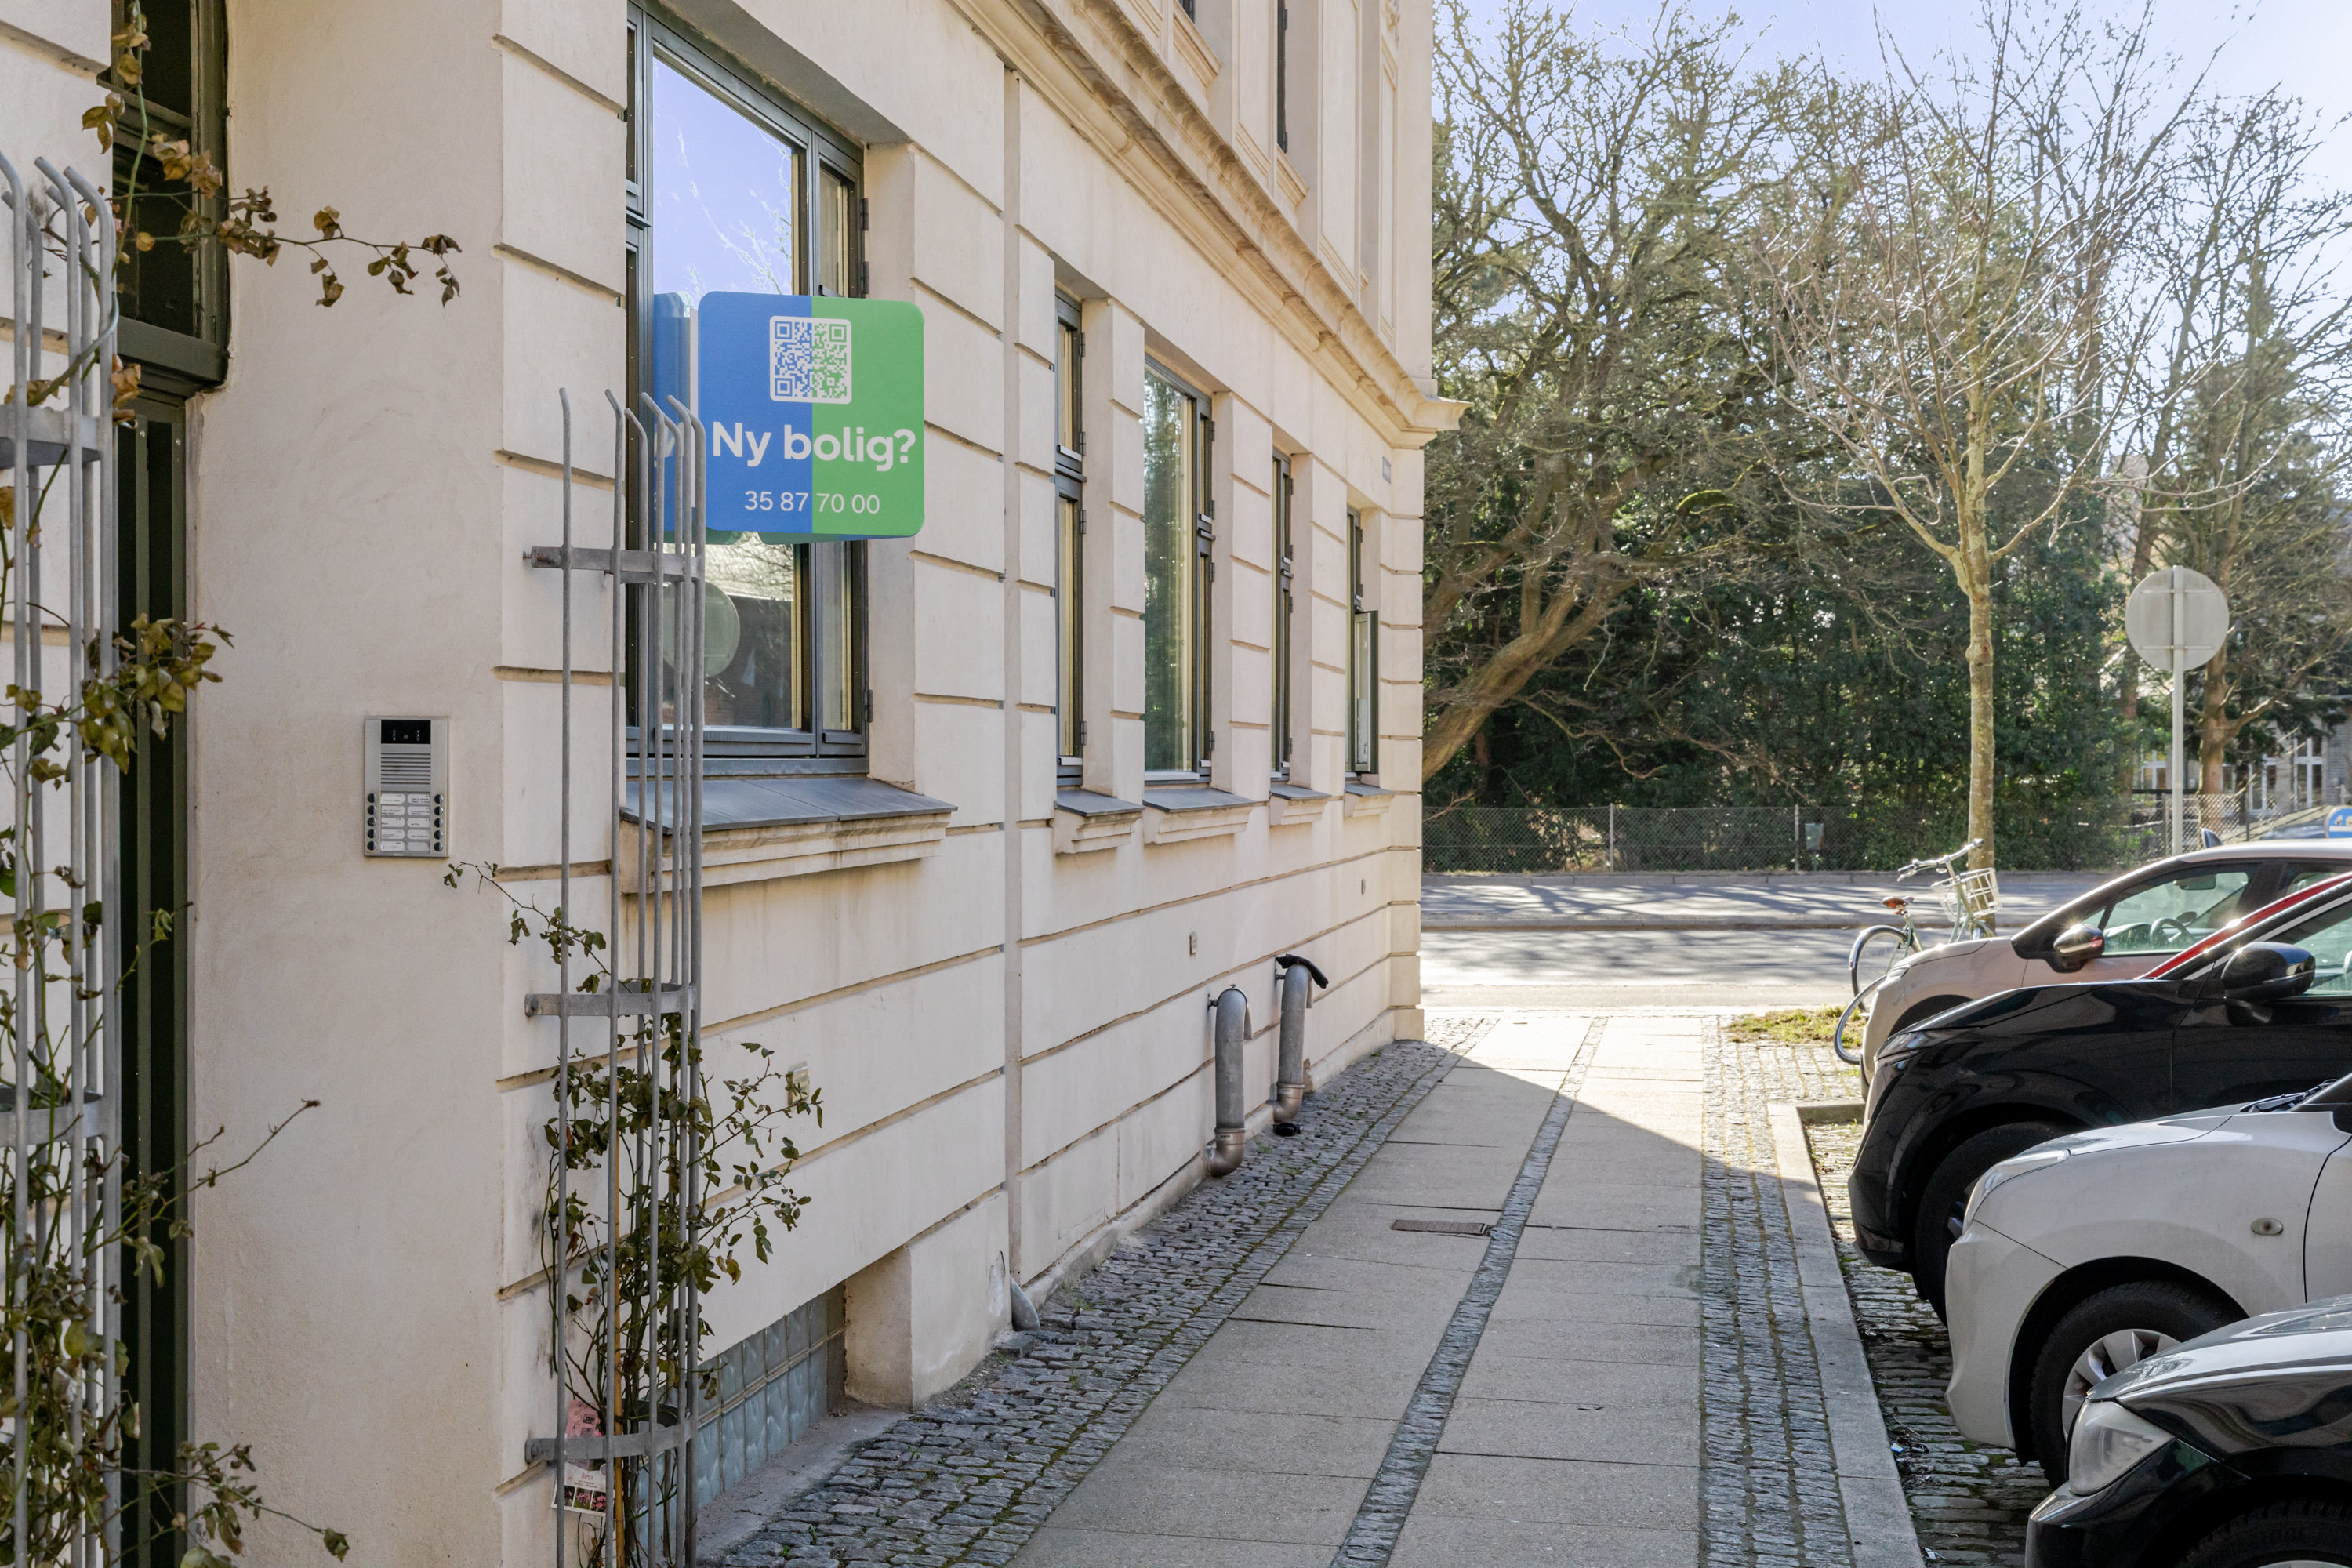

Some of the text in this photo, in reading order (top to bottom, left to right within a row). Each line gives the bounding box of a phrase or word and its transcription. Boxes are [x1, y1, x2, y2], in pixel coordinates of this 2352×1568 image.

[713, 421, 772, 467] Ny
[784, 424, 916, 472] bolig?
[744, 490, 880, 514] 35 87 70 00
